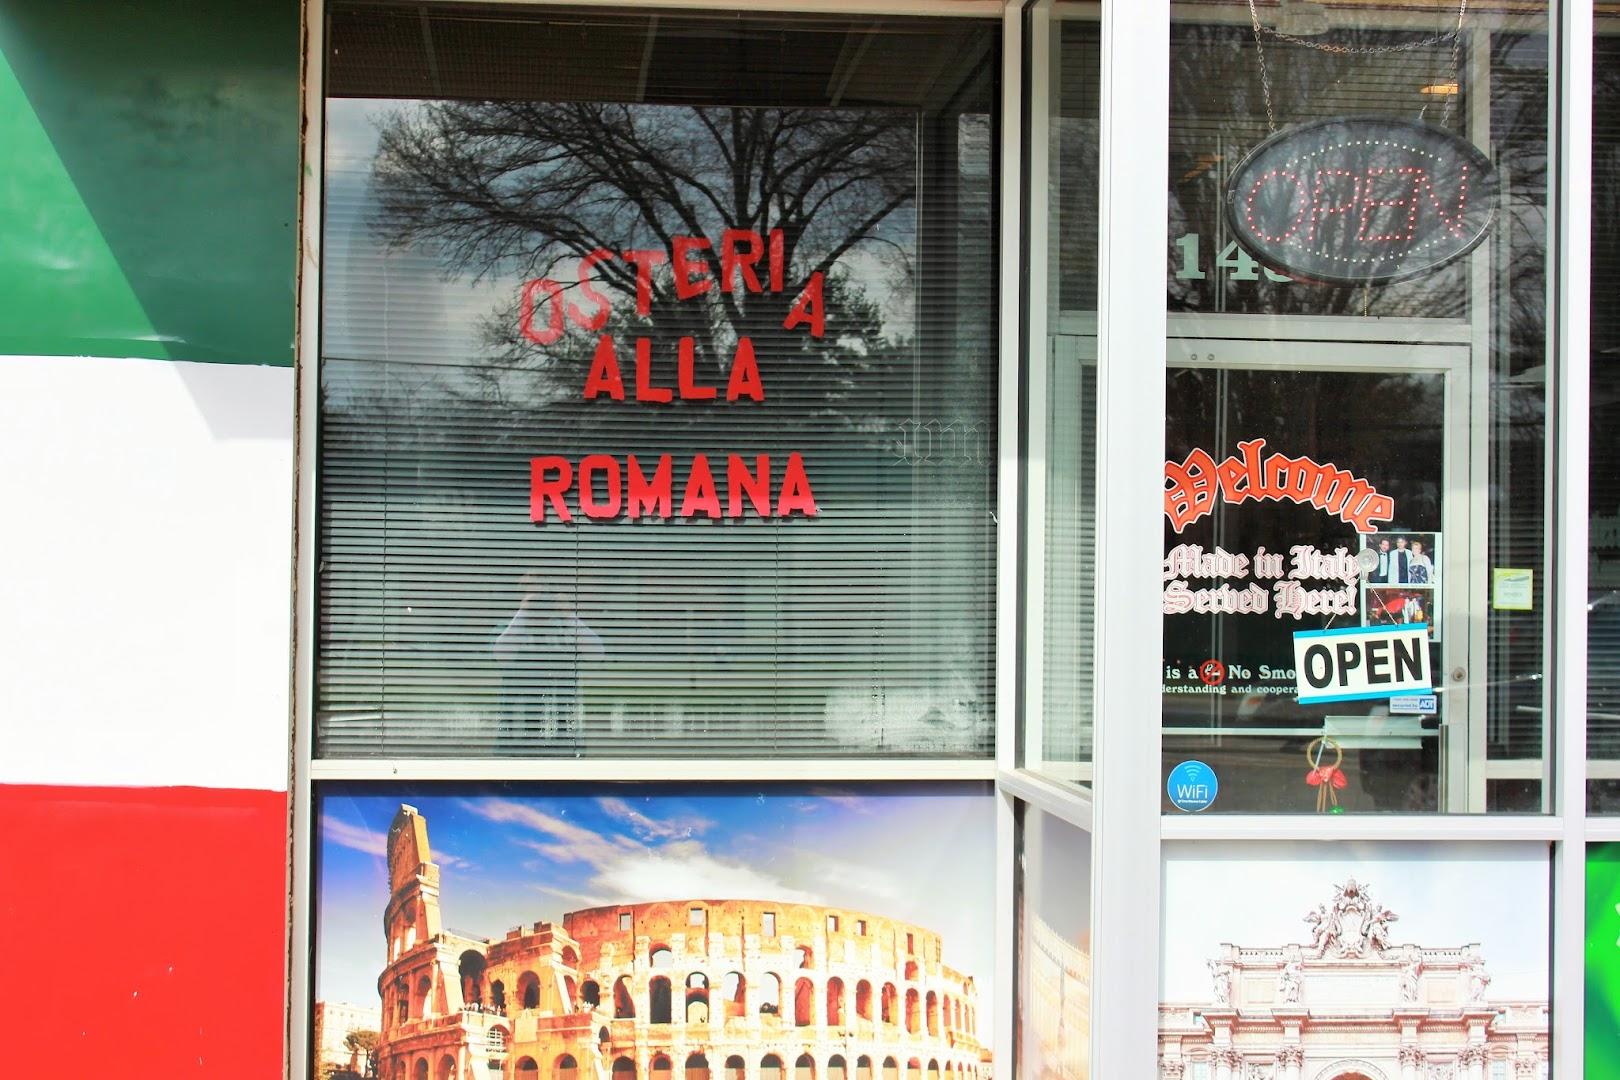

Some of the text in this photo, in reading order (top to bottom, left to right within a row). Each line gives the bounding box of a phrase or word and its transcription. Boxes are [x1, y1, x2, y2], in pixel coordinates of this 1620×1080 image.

[1247, 164, 1470, 242] OPEN
[1175, 233, 1294, 282] 14
[583, 335, 765, 402] ALLA
[530, 452, 817, 522] ROMANA
[1164, 438, 1394, 533] Welcome
[1164, 543, 1360, 586] Made in Italy
[1163, 580, 1269, 615] Served
[1165, 664, 1297, 680] is a No Smo
[1303, 637, 1423, 690] OPEN
[1231, 684, 1252, 693] and
[1176, 783, 1208, 800] WiFi
